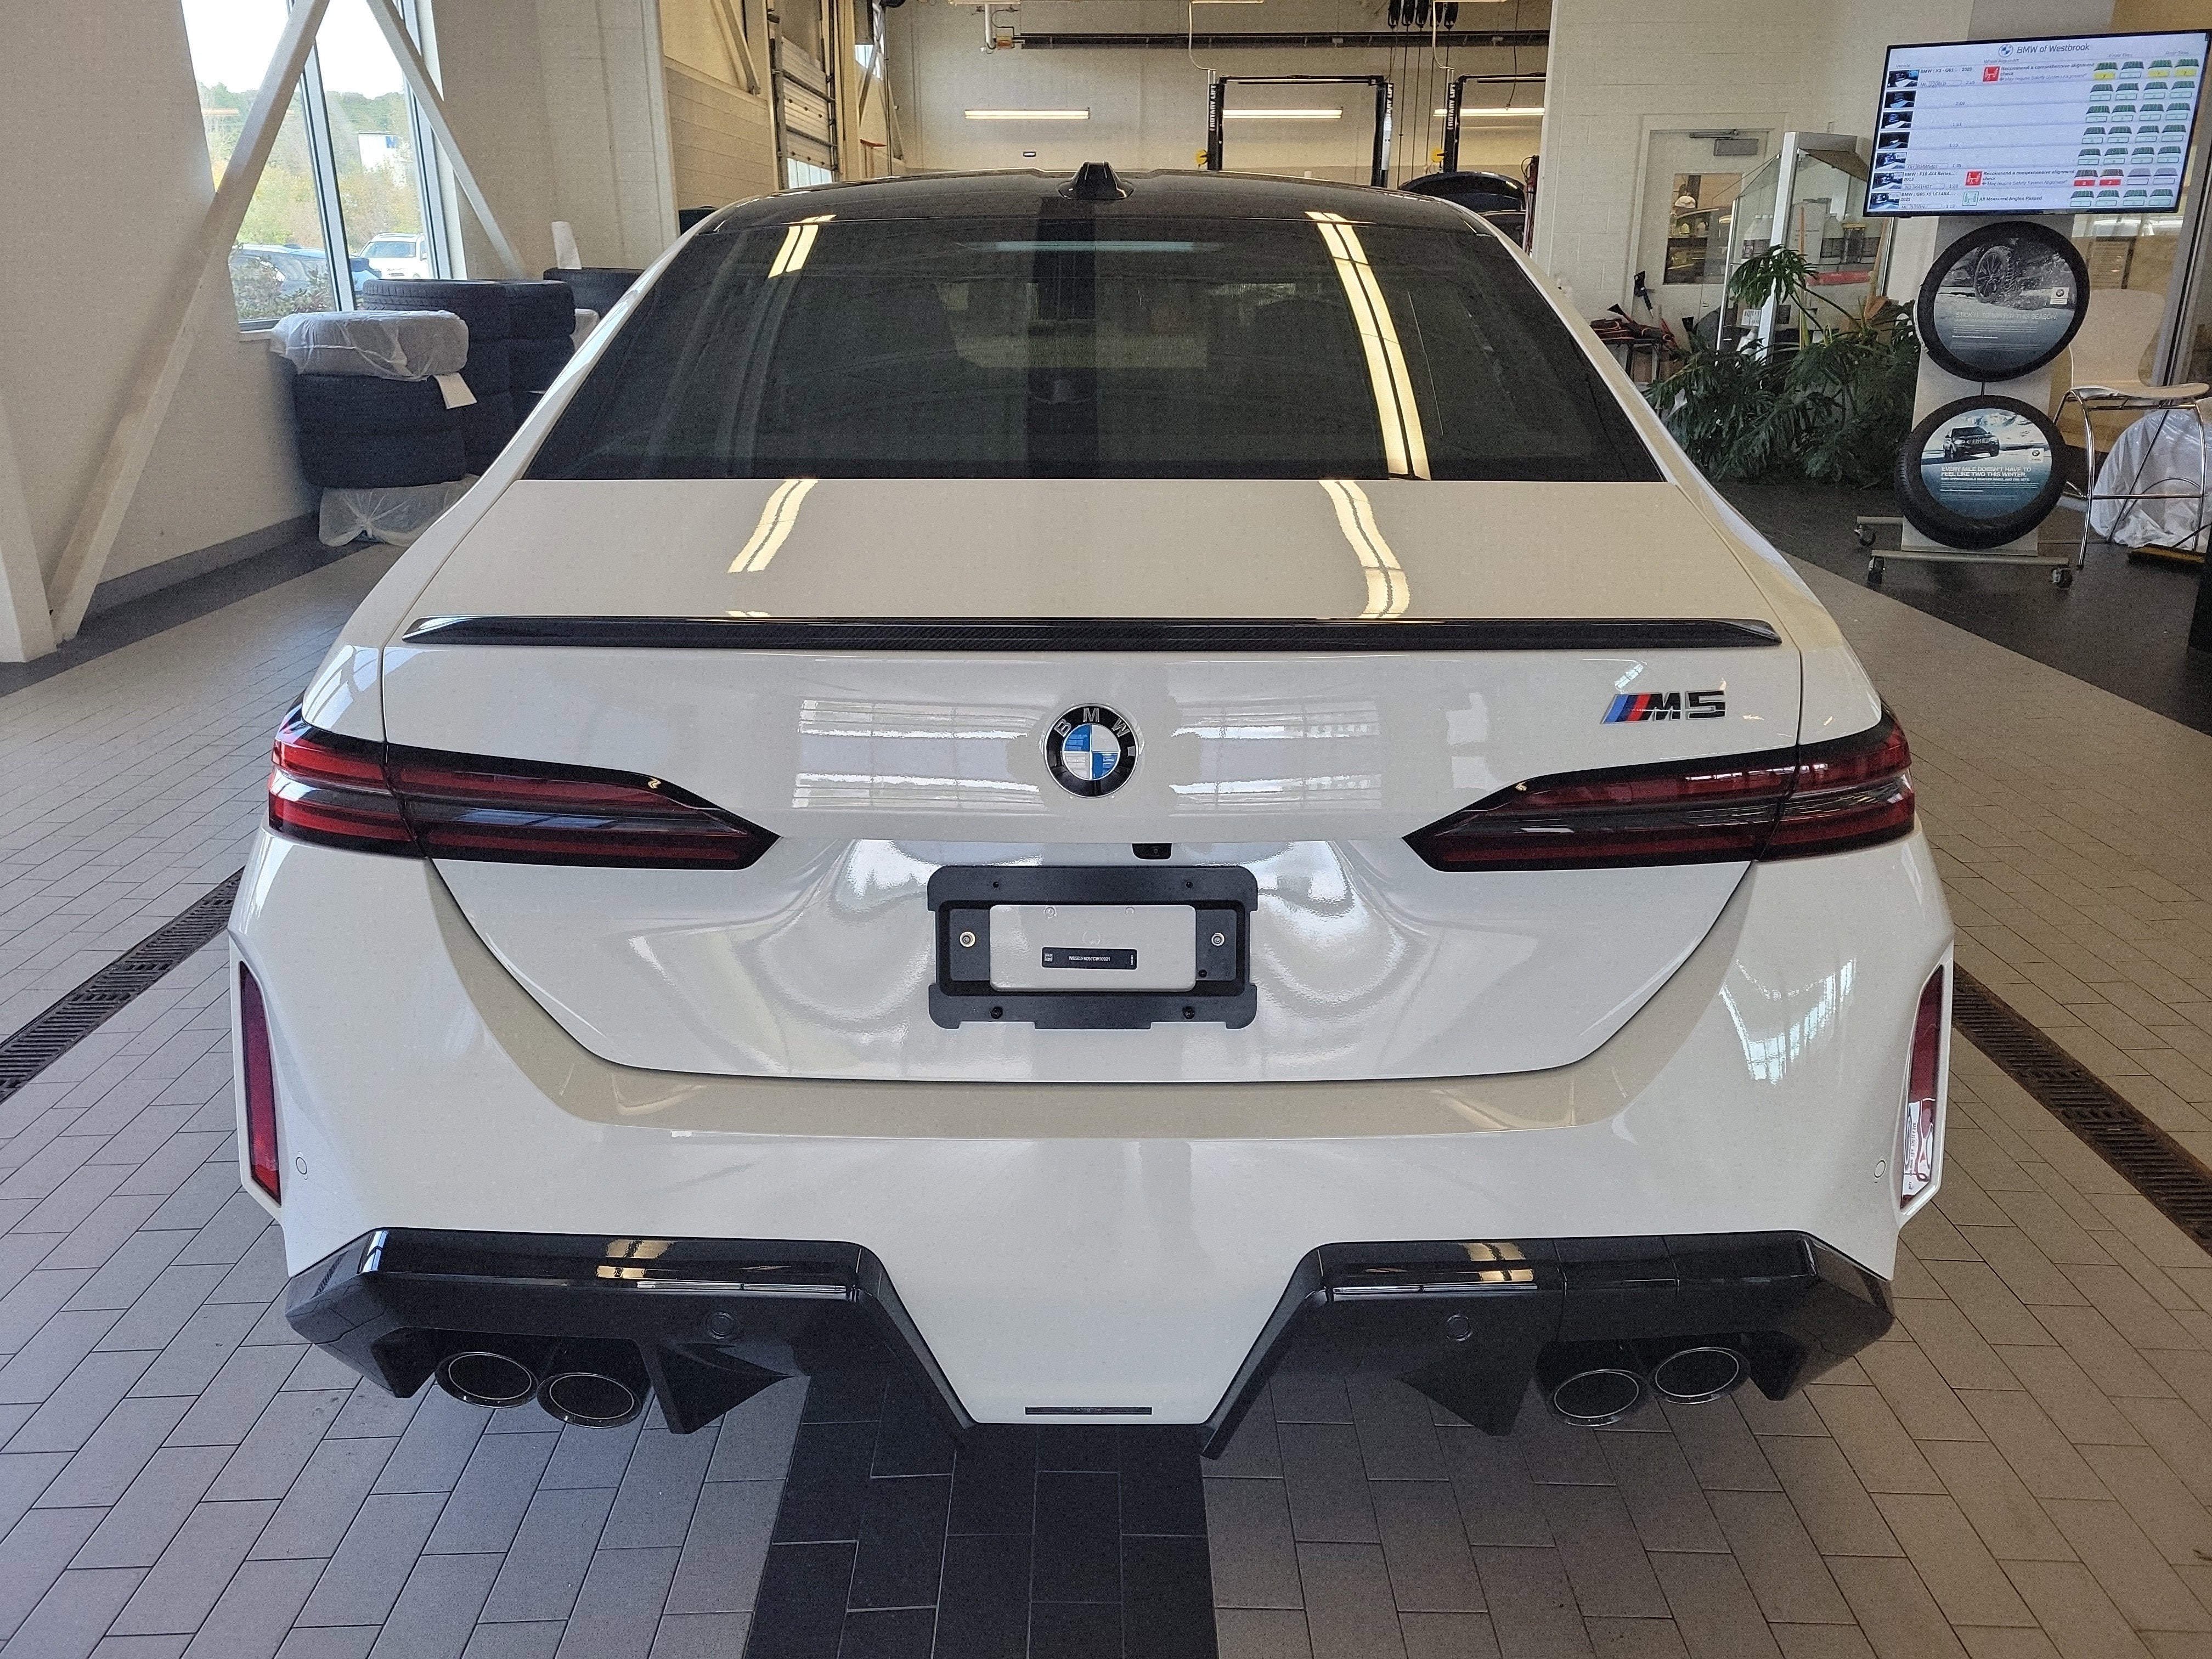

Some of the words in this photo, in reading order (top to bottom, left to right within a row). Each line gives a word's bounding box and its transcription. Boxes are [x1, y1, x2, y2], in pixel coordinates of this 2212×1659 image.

[2017, 46, 2038, 54] BMW
[2050, 43, 2090, 52] Westbrook
[1635, 690, 1727, 723] M5
[1053, 708, 1130, 737] BMW
